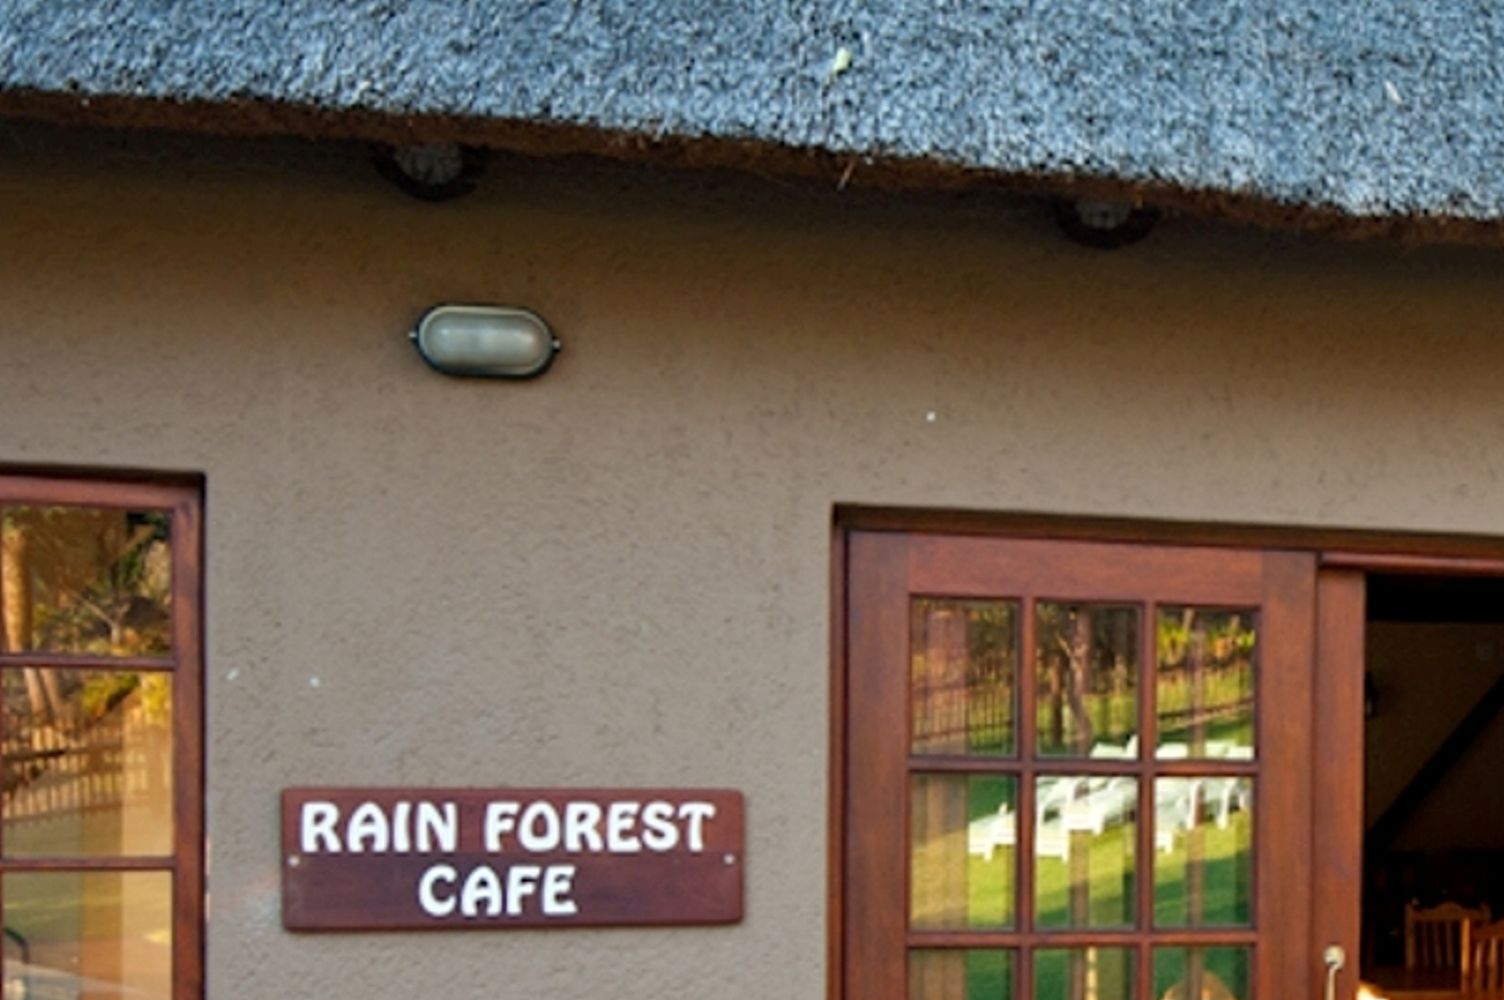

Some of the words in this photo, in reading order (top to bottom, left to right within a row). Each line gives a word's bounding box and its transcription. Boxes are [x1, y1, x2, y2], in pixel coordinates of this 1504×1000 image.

[301, 801, 457, 853] RAIN
[485, 801, 716, 853] FOREST
[419, 865, 577, 916] CAFE
